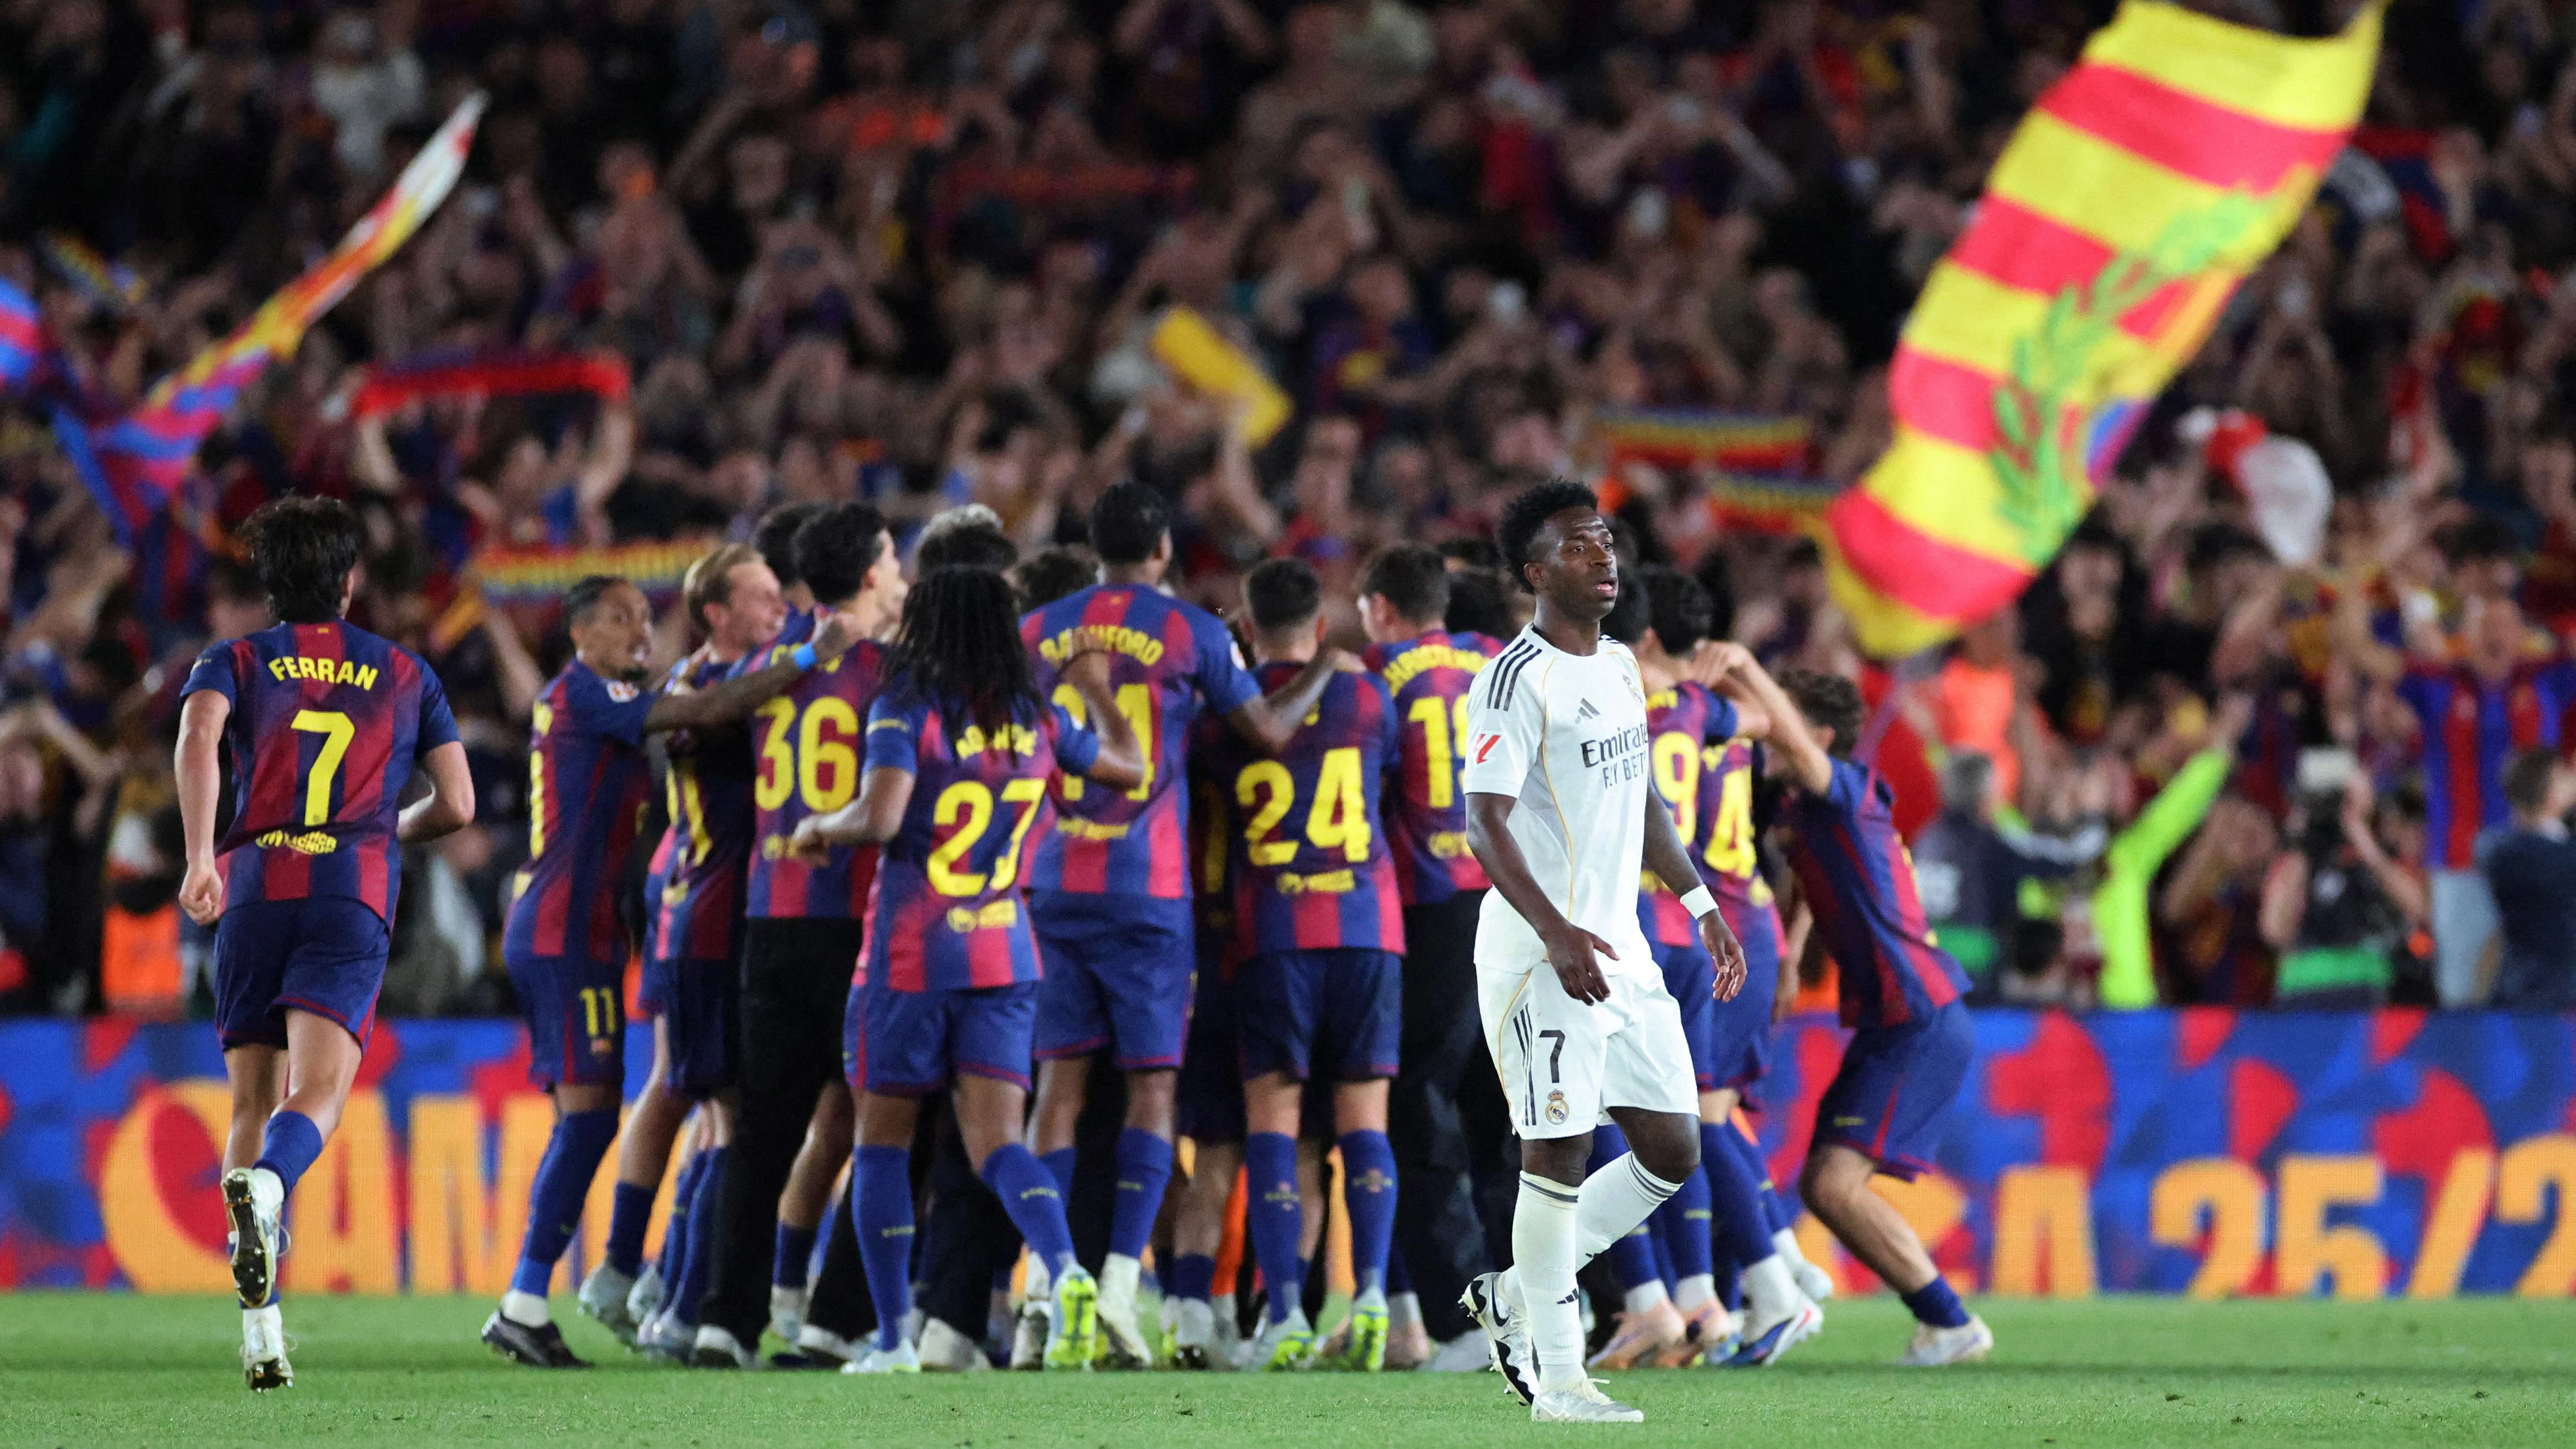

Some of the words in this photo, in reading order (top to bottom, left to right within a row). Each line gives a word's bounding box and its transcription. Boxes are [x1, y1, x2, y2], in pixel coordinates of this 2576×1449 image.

[267, 656, 379, 691] FERRAN
[290, 709, 355, 826] 7
[754, 695, 859, 813] 36
[1580, 721, 1649, 769] Emirate
[1235, 747, 1371, 866] 24
[580, 987, 617, 1037] 11
[1539, 1029, 1566, 1083] 7
